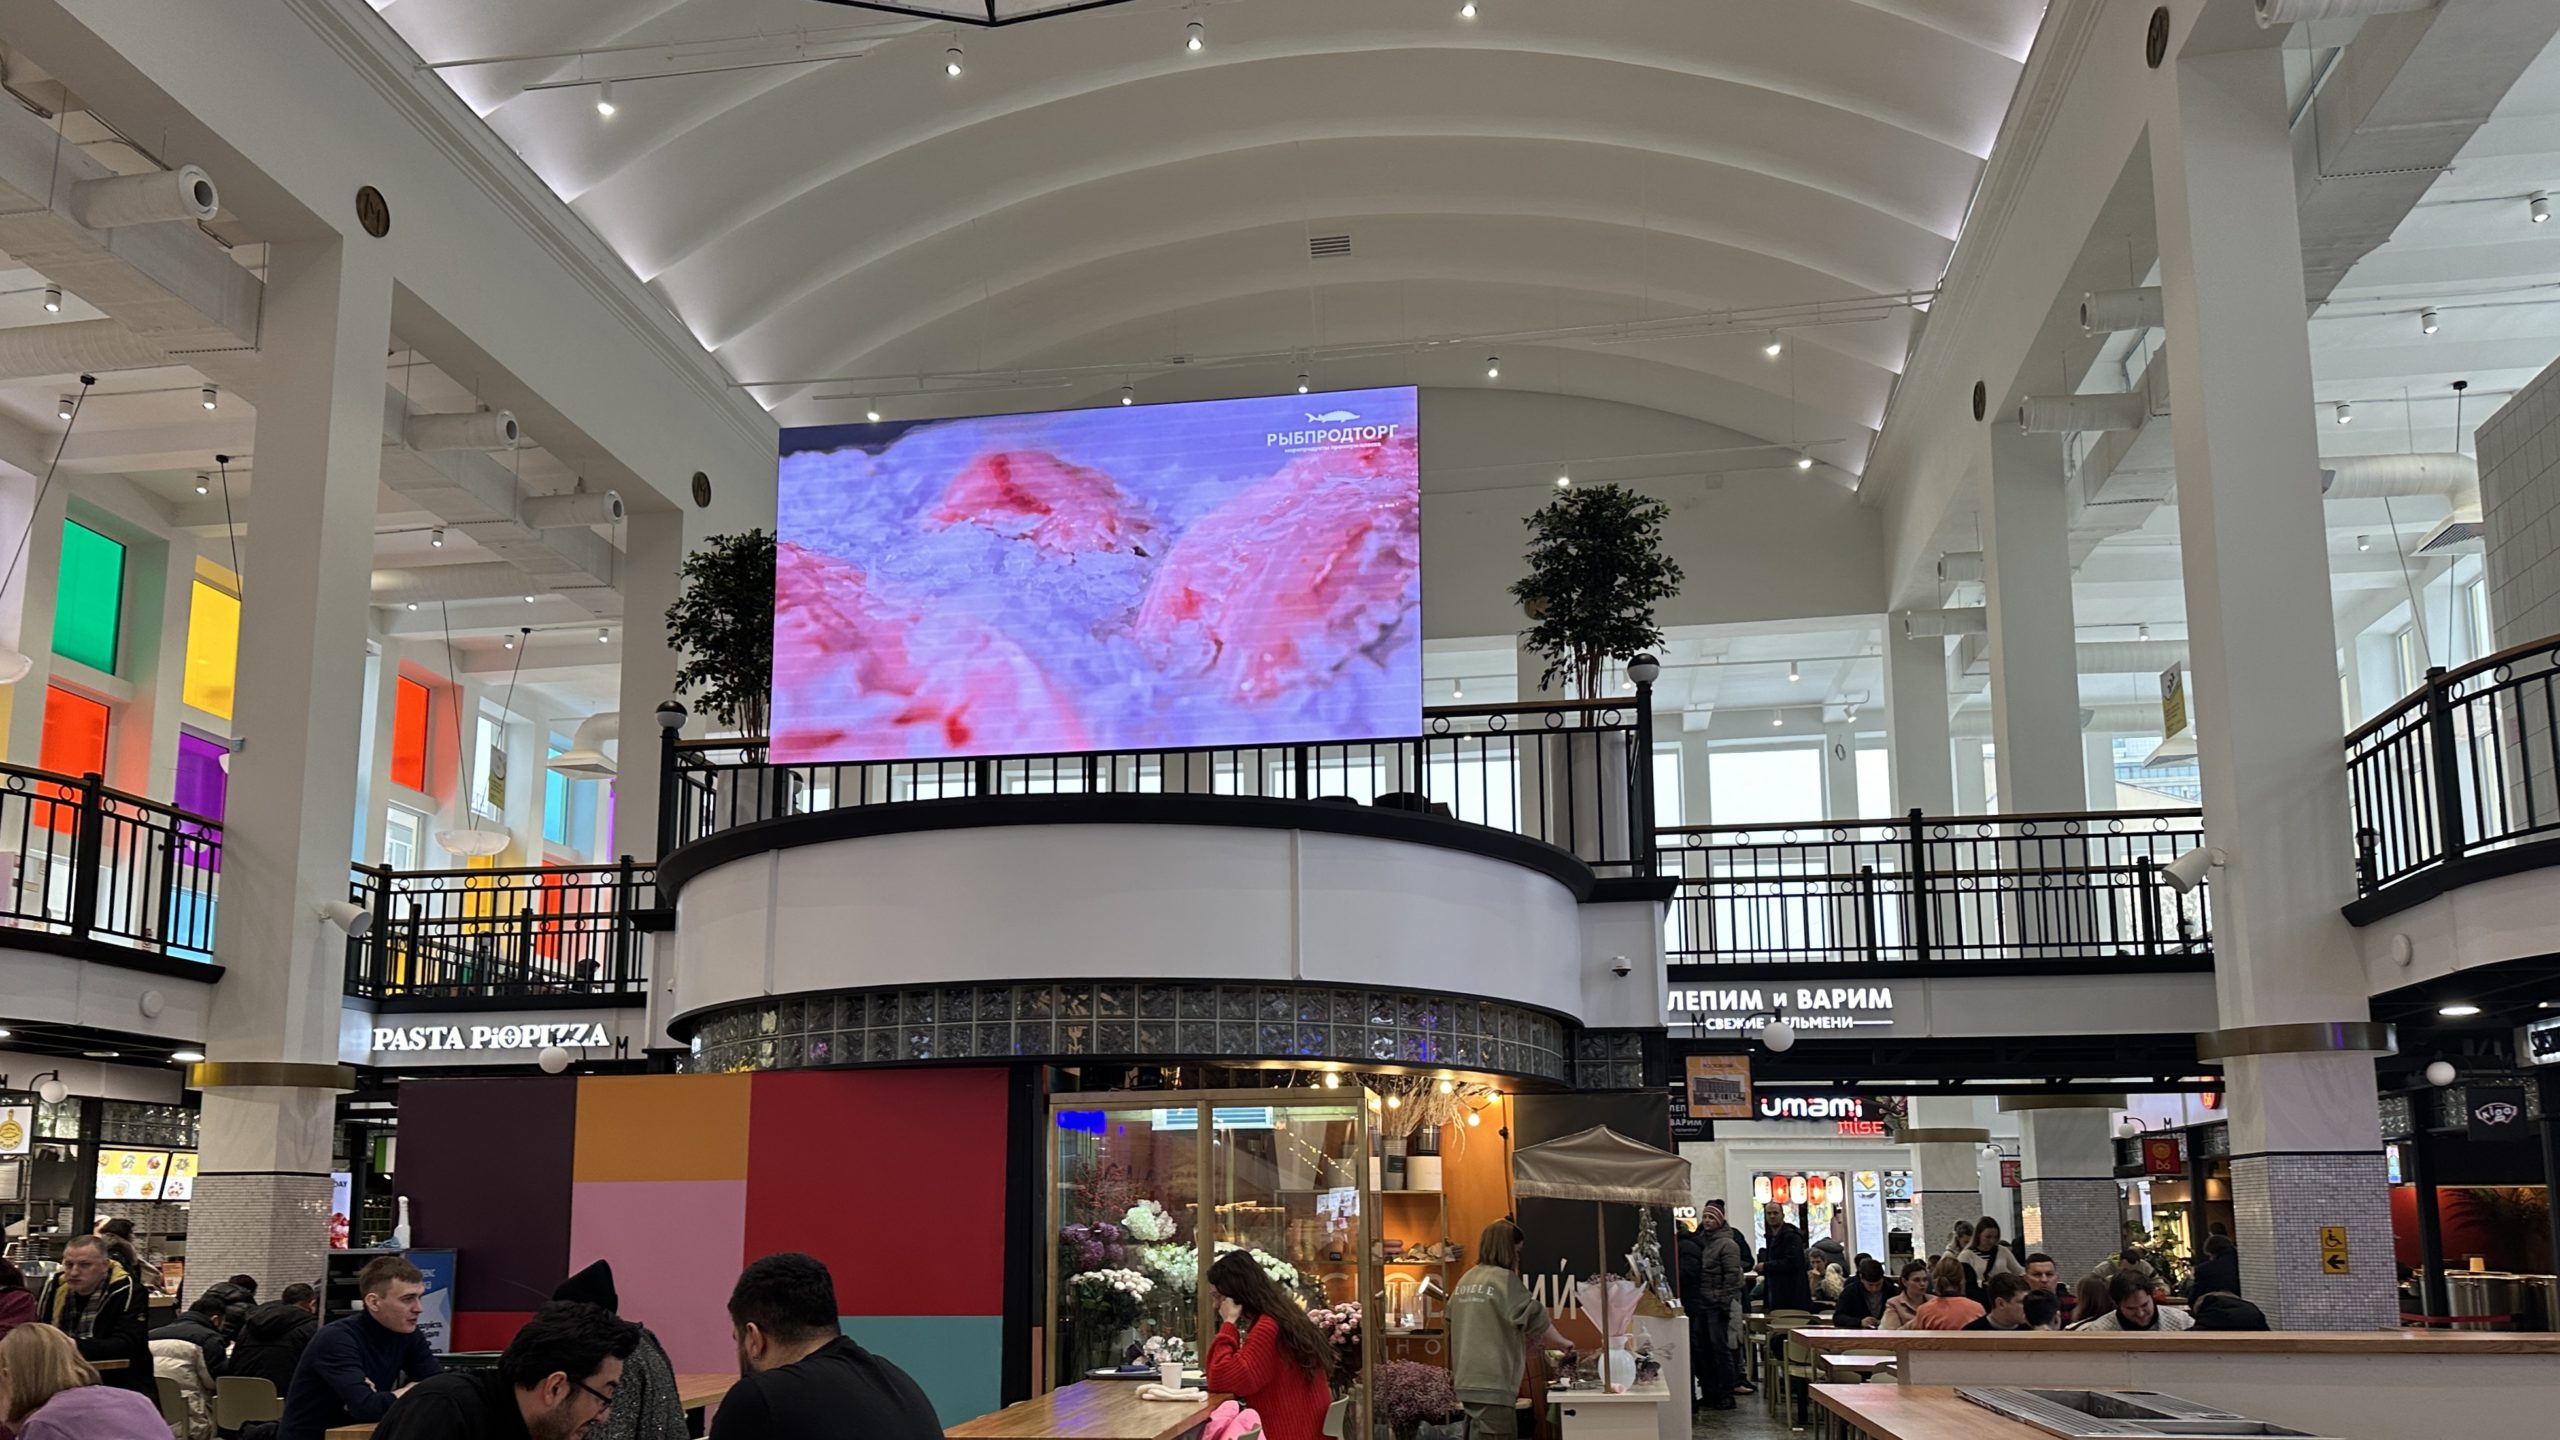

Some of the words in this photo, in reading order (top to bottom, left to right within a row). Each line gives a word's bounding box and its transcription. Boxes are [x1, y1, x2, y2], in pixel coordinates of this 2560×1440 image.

[1267, 424, 1399, 447] РЫБПРОДТОРГ
[1667, 989, 1764, 1011] ЛЕПИМ
[1797, 987, 1894, 1010] ВАРИМ
[1705, 1017, 1765, 1030] СВЕЖИЕ
[1770, 1016, 1854, 1030] ЕЛЬМЕНИ
[372, 1026, 466, 1051] PASTA
